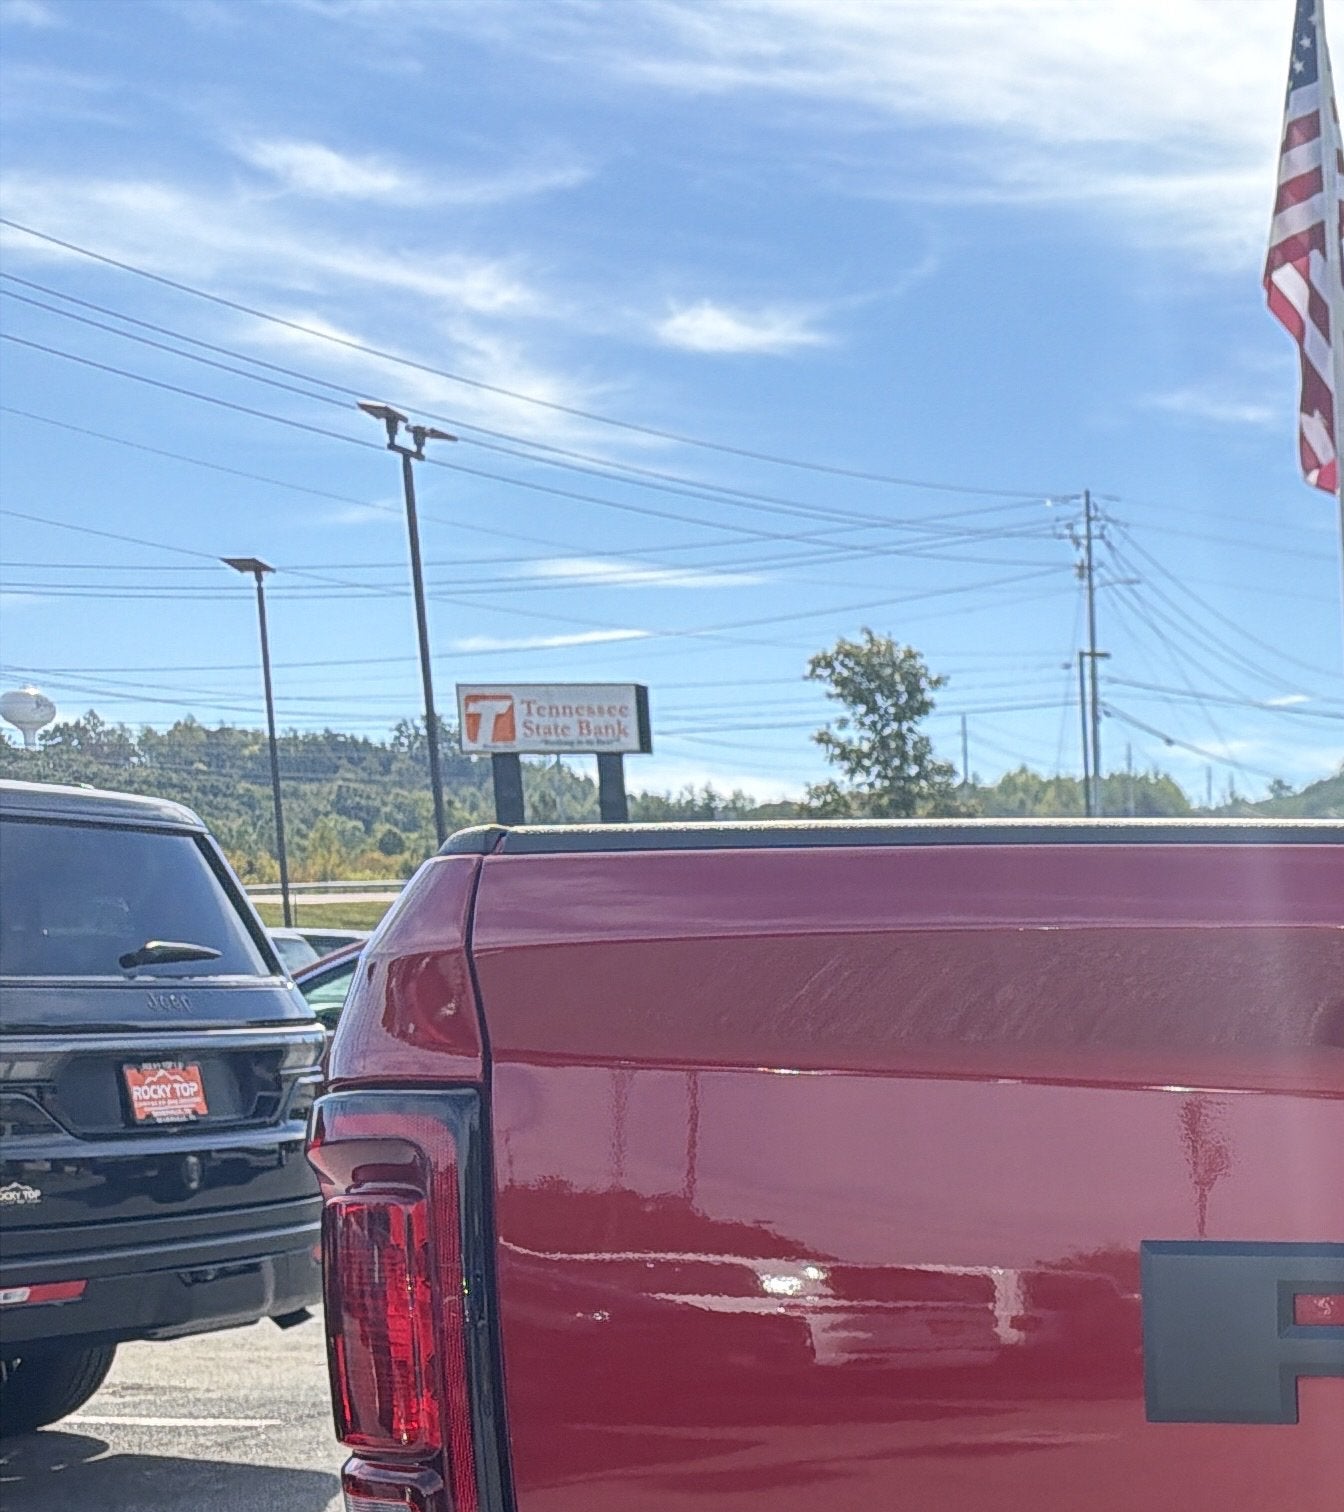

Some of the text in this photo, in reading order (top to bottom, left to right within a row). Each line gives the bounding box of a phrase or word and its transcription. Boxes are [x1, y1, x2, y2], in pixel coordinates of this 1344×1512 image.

[520, 700, 629, 718] Tennessee
[522, 719, 629, 738] State Bank
[147, 992, 193, 1014] Jeep
[132, 1081, 199, 1101] ROCKY TOP
